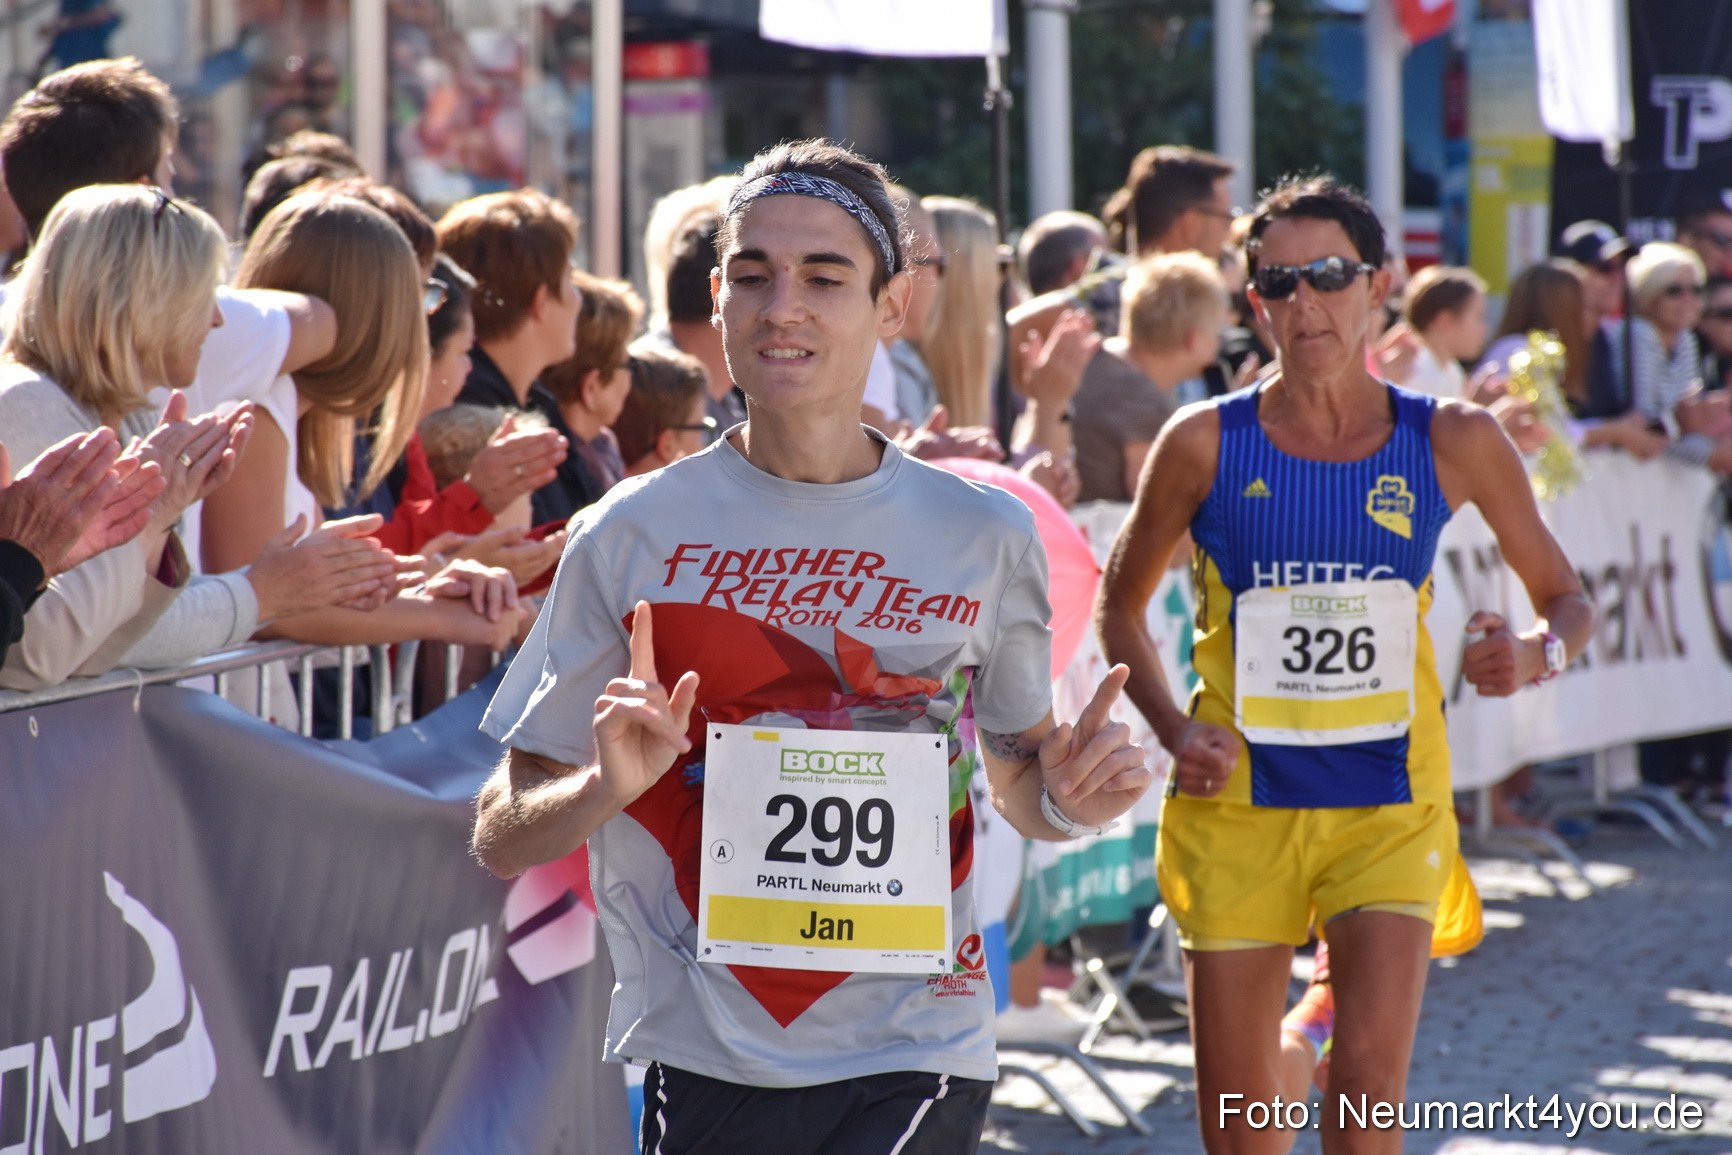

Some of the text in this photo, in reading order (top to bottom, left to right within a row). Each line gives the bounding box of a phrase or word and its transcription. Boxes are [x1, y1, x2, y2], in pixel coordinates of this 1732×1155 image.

[662, 543, 886, 587] FINISHER
[700, 571, 982, 627] RELAY TEAM
[1291, 595, 1367, 614] BOCK
[763, 601, 923, 634] ROTH 2016
[1282, 626, 1376, 675] 326
[1276, 681, 1366, 693] PARTL Neumarkt
[780, 748, 886, 777] BOCK
[780, 773, 887, 786] inspired by smart concepts
[764, 793, 895, 868] 299
[717, 846, 726, 858] A
[757, 874, 882, 894] PARTL Neumarkt
[800, 911, 854, 941] Jan
